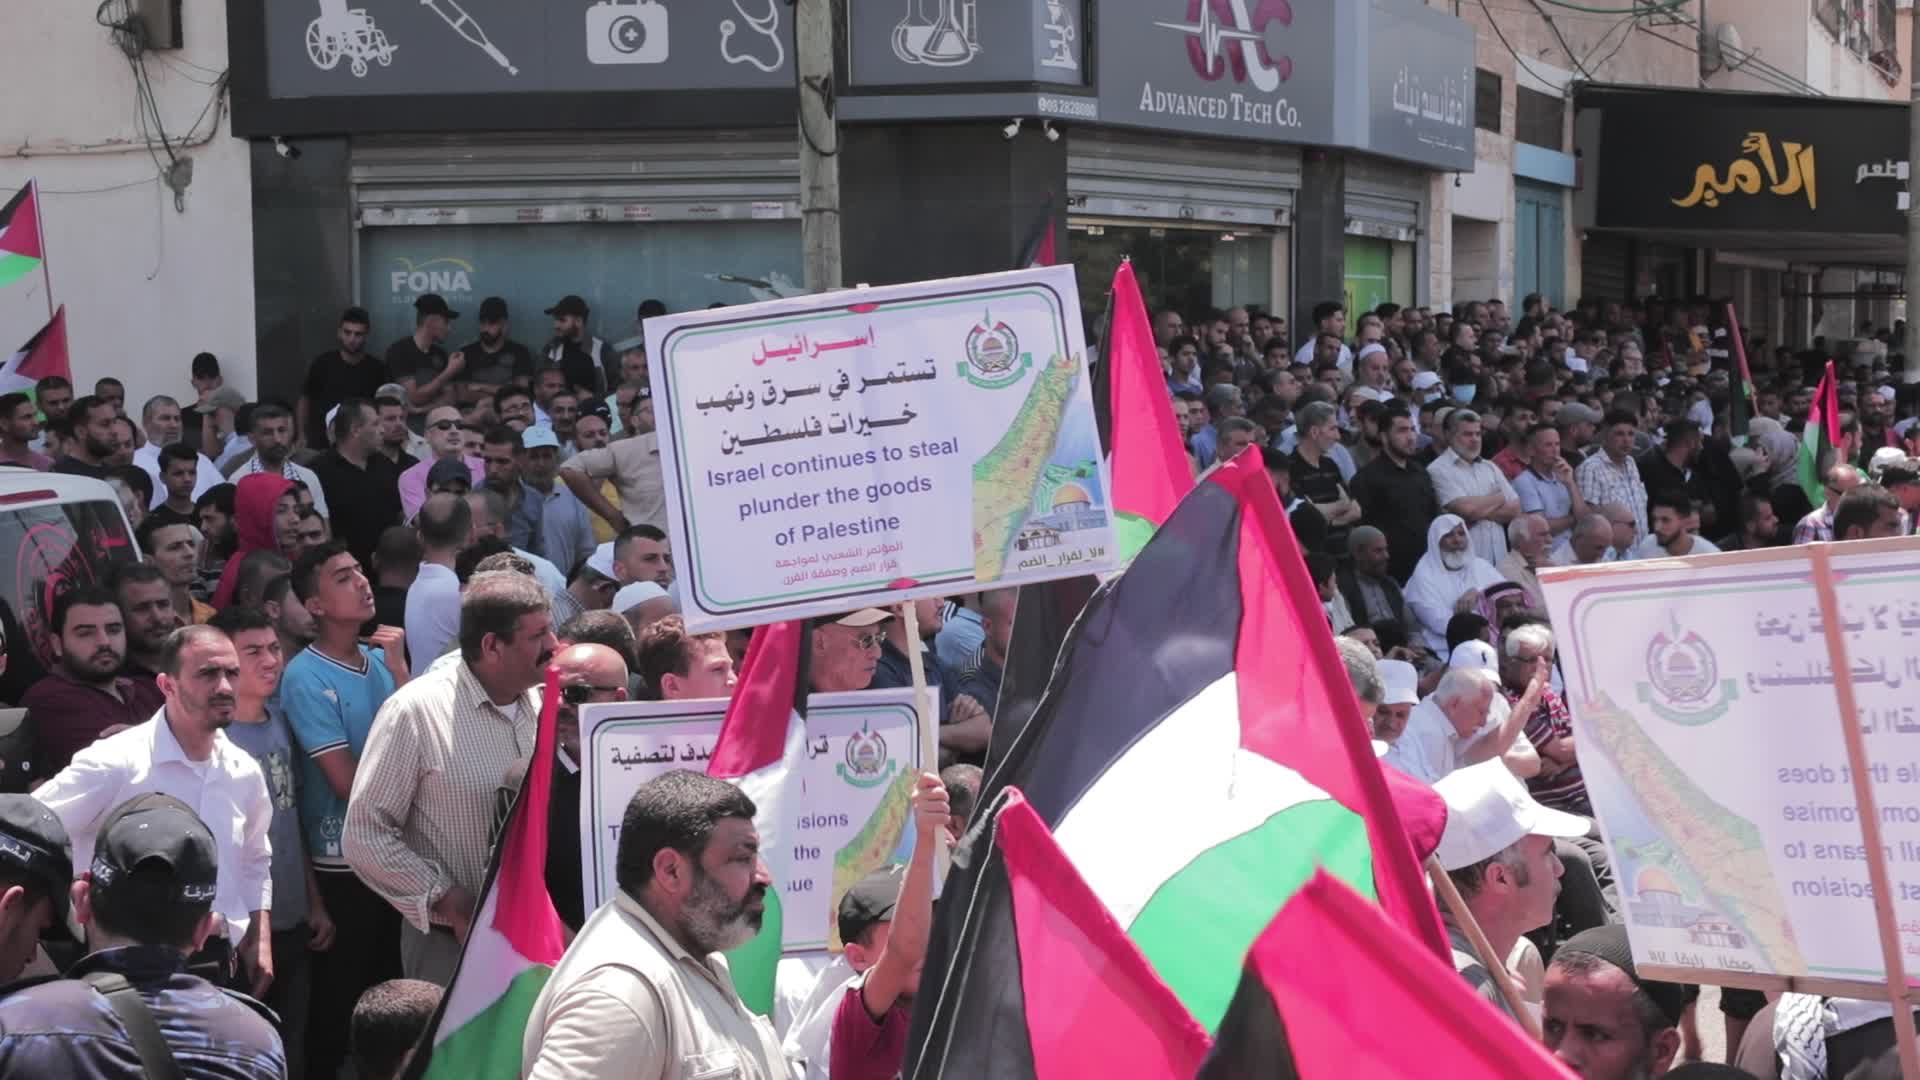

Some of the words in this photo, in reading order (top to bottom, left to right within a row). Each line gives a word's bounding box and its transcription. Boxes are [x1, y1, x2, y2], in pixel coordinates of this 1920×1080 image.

[1671, 132, 1816, 211] الأمير
[391, 271, 472, 293] FONA
[761, 379, 822, 406] سرق
[828, 368, 850, 402] في
[857, 358, 937, 394] تستمر
[695, 383, 755, 416] ونهب
[720, 415, 823, 456] فلسطين
[828, 402, 918, 437] خيرات
[707, 462, 766, 488] Israel
[771, 448, 877, 478] continues
[882, 446, 903, 462] to
[909, 437, 959, 459] steal
[739, 491, 821, 520] plunder
[826, 486, 861, 505] the
[866, 475, 932, 503] goods
[775, 528, 795, 547] of
[801, 515, 901, 543] Palestine
[611, 745, 676, 771] لتصفية
[796, 811, 850, 830] isions
[794, 844, 821, 861] the
